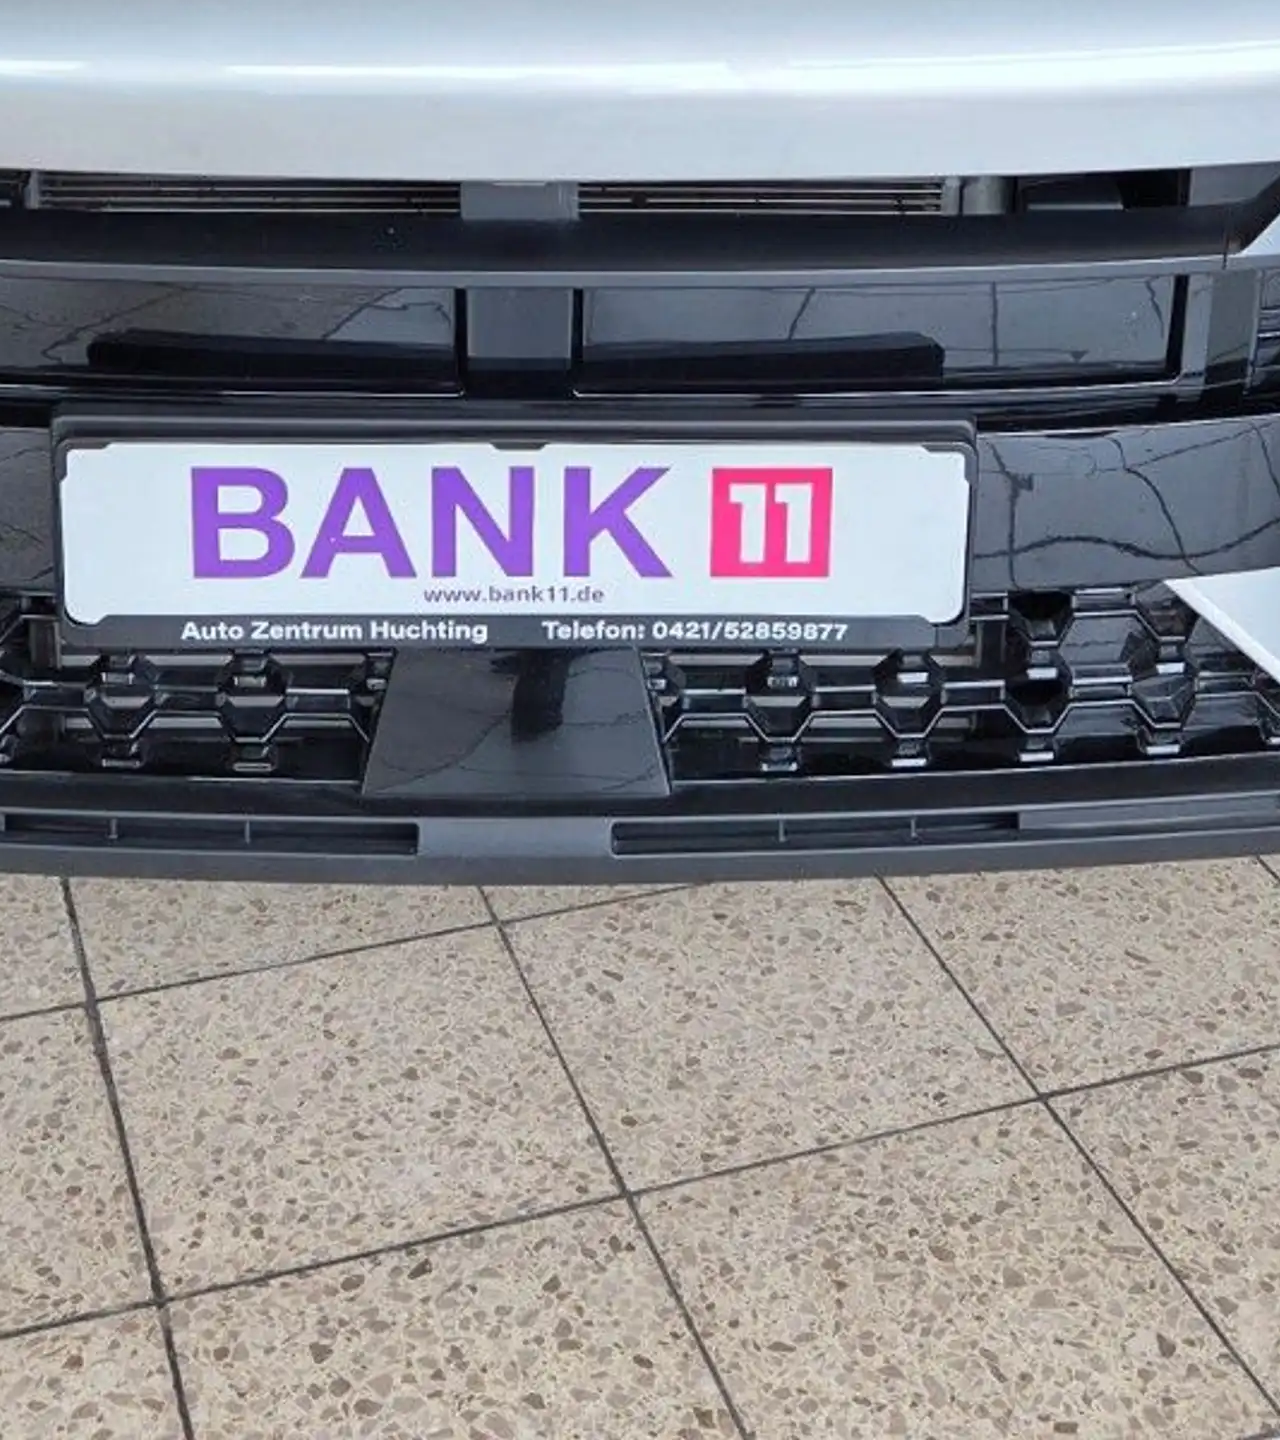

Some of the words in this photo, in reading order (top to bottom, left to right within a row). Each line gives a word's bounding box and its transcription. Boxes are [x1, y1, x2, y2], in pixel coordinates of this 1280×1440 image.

[191, 466, 673, 578] BANK
[728, 482, 814, 564] 11
[424, 585, 605, 603] www.bank11.de
[181, 621, 244, 640] Auto
[250, 621, 363, 640] Zentrum
[371, 620, 489, 644] Huchting
[542, 621, 646, 640] Telefon:
[652, 621, 849, 641] 0421/52859877
